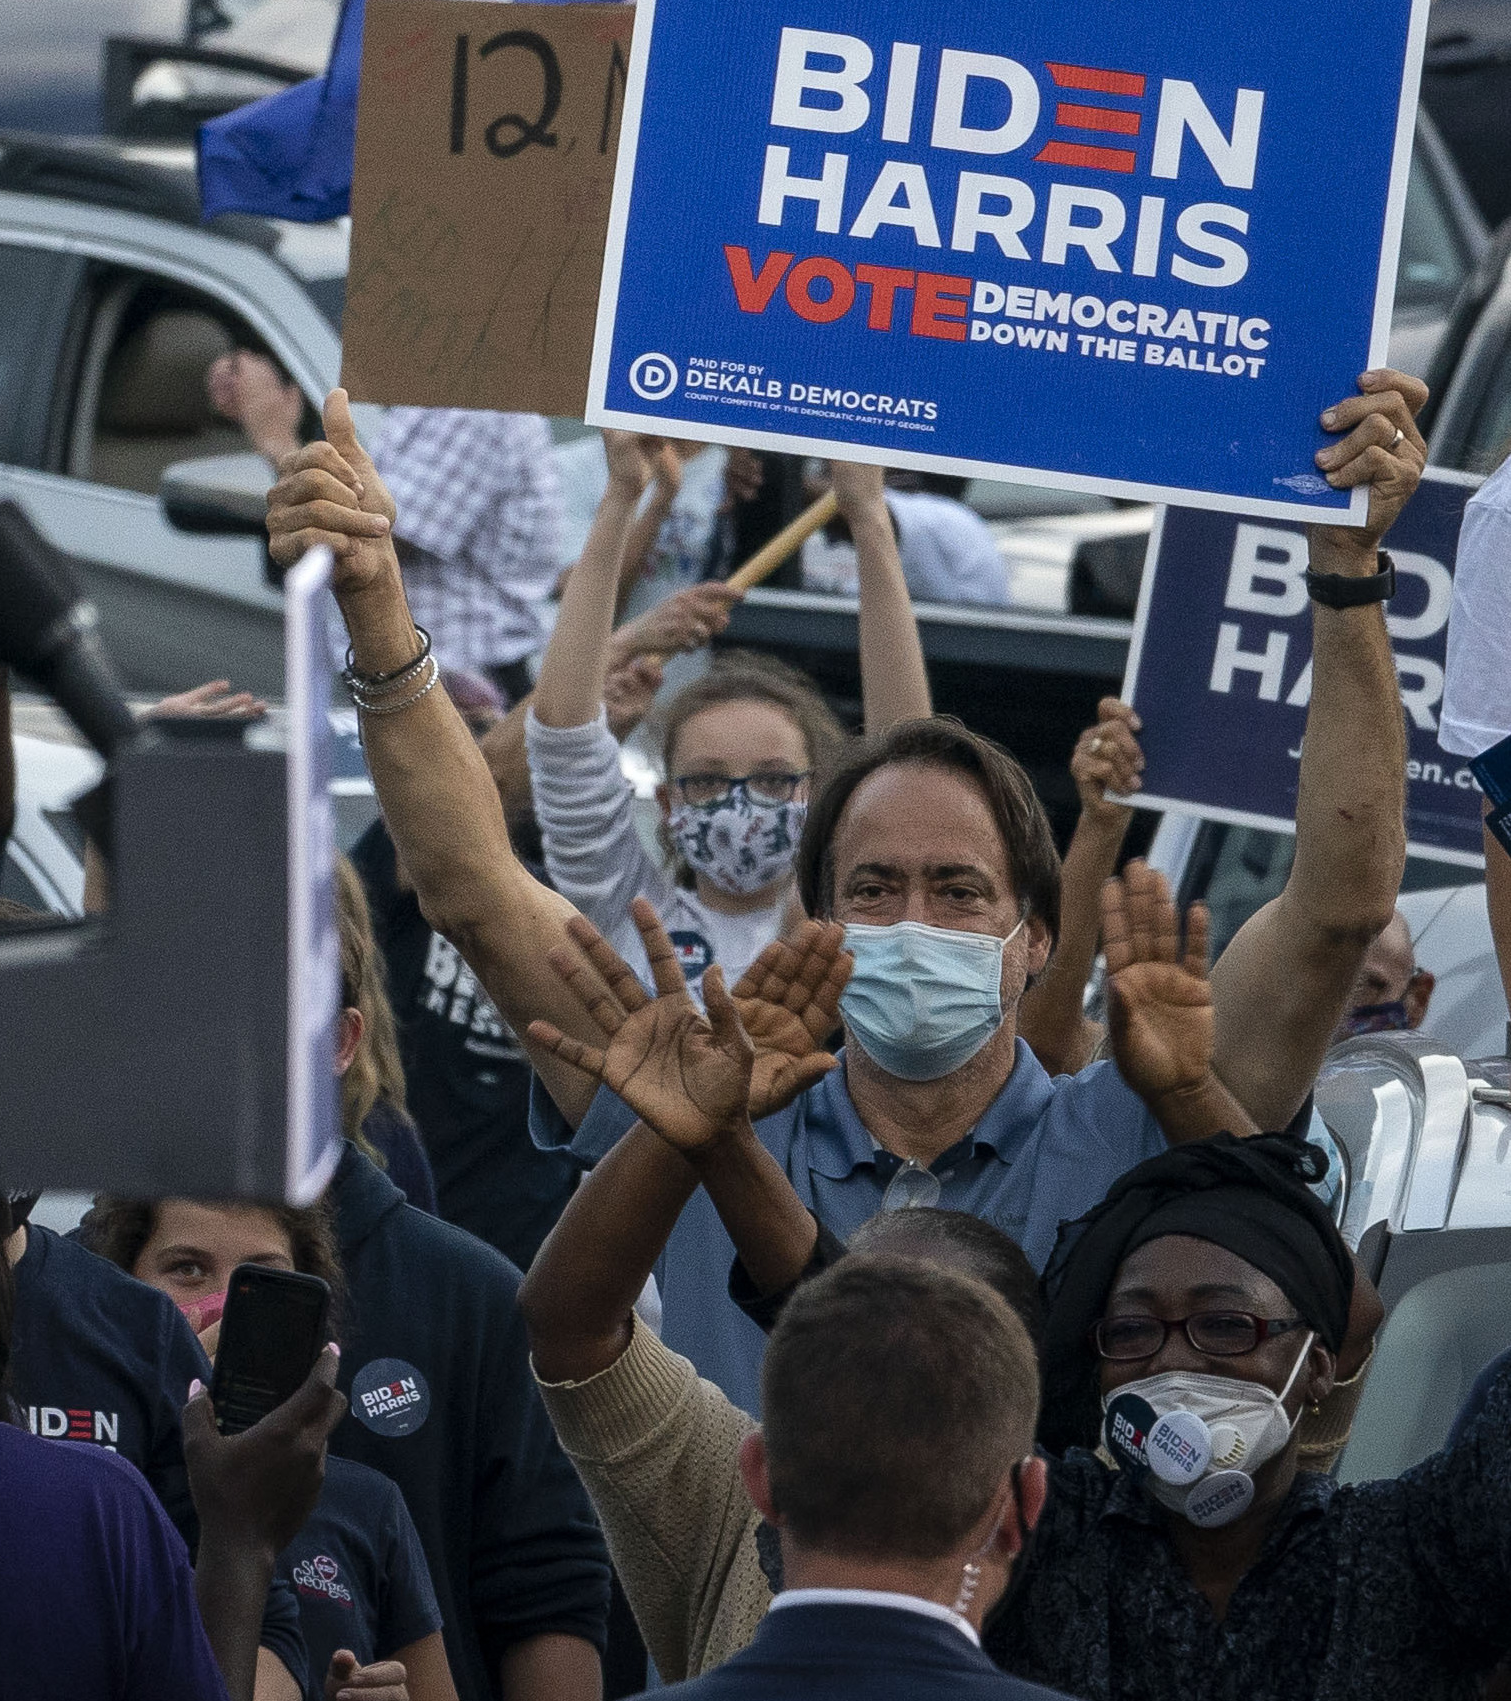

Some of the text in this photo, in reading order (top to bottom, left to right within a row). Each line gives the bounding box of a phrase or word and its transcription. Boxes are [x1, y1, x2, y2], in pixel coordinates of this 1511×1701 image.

[769, 25, 1265, 190] BIDEN
[756, 144, 1250, 288] HARRIS
[722, 244, 973, 343] VOTE
[972, 279, 1271, 352] DEMOCRATIC
[688, 357, 765, 377] PAID FOR BY
[970, 318, 1266, 380] DOWN THE BALLOT
[684, 391, 936, 432] COUNTY COMMITTEE OF THE DEMOCRATIC PARTY OF GEORGIA
[685, 369, 938, 421] DEKALB DEMOCRATS
[360, 1376, 417, 1408] BIDEN
[367, 1389, 421, 1419] HARRIS
[29, 1406, 119, 1443] IDEN
[1158, 1422, 1202, 1463] BIDEN
[1152, 1434, 1194, 1474] HARRIS
[1191, 1479, 1243, 1513] BIDEN
